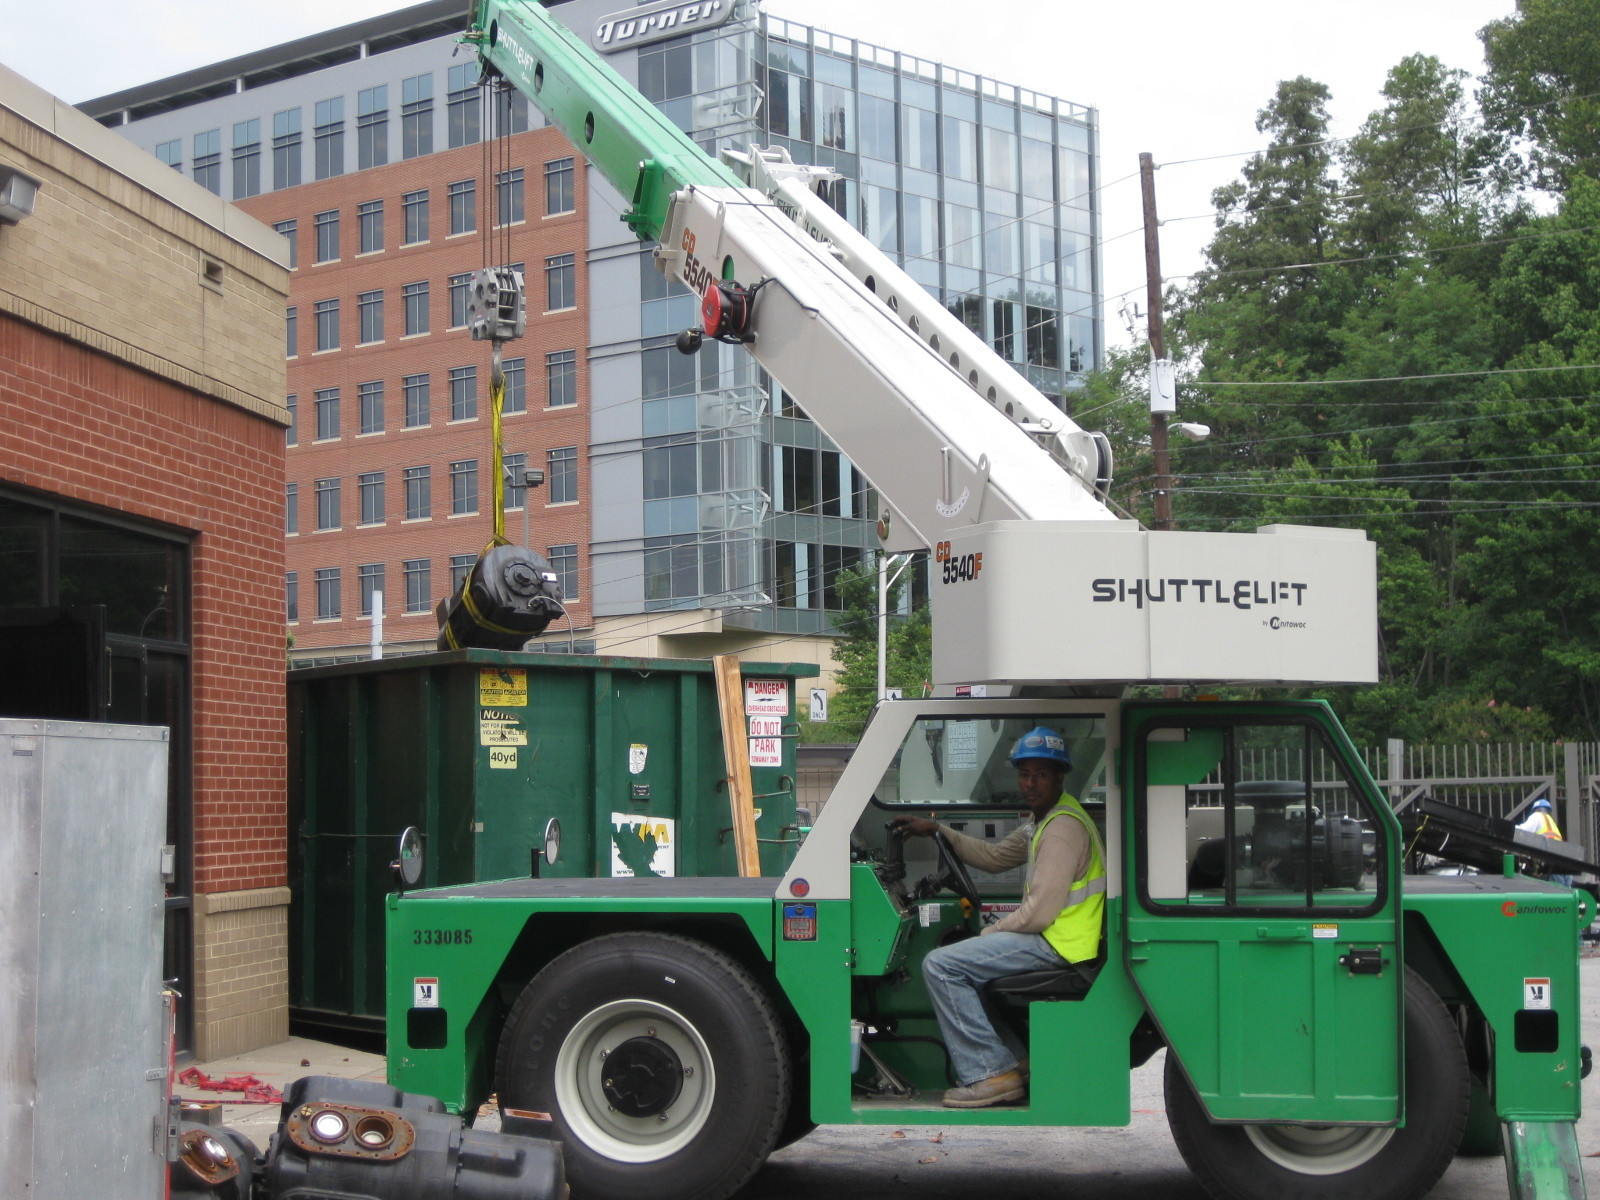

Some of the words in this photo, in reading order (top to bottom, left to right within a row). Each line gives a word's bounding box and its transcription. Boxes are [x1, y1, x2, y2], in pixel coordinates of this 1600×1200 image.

[597, 1, 720, 44] Turner
[497, 27, 533, 71] SHUTTLELIFT
[682, 227, 696, 254] CD
[936, 541, 951, 563] CD
[943, 552, 983, 585] 5540F
[1092, 578, 1308, 609] SHUTTLELIFT
[755, 683, 780, 695] DANGER
[767, 705, 786, 713] OBSTACLES
[812, 711, 824, 719] ONLY
[751, 720, 762, 735] DO
[763, 721, 780, 735] NOT
[754, 739, 776, 753] PARK
[490, 751, 516, 764] 40yd
[1501, 900, 1568, 918] Manitowoc
[413, 929, 473, 946] 333085
